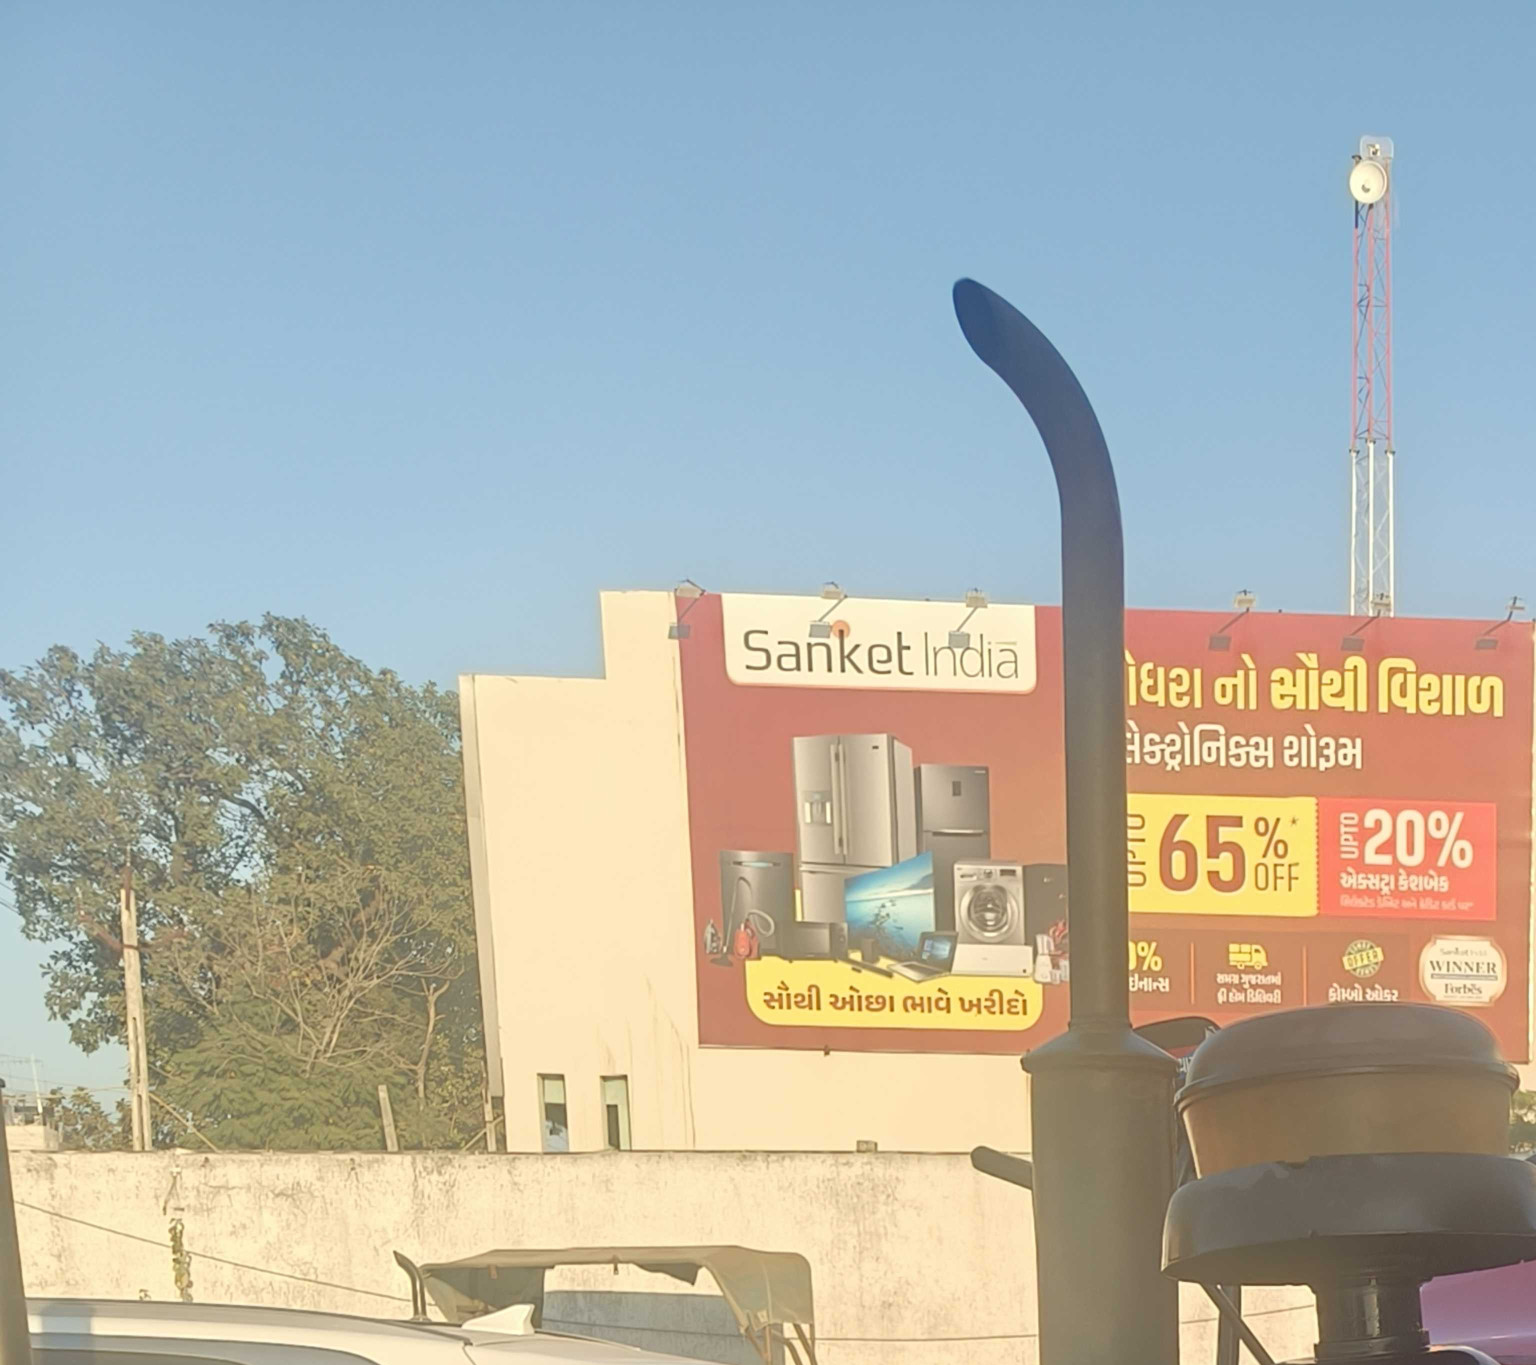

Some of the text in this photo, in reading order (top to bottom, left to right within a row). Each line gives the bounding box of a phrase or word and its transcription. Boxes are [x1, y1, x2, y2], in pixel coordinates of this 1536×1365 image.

[743, 629, 1019, 679] Sanket India
[1125, 650, 1504, 717] ોધરા નો સૌથી વિશાળ
[1283, 723, 1362, 772] શોરૂમ
[1339, 808, 1473, 868] UPTO 20%
[1254, 862, 1300, 892] OFF
[1346, 949, 1378, 968] OFFER
[1429, 960, 1497, 974] WINNER
[763, 981, 1028, 1016] સૌથી ઓછા ભાવે ખરીદો
[1444, 983, 1483, 995] Forbes
